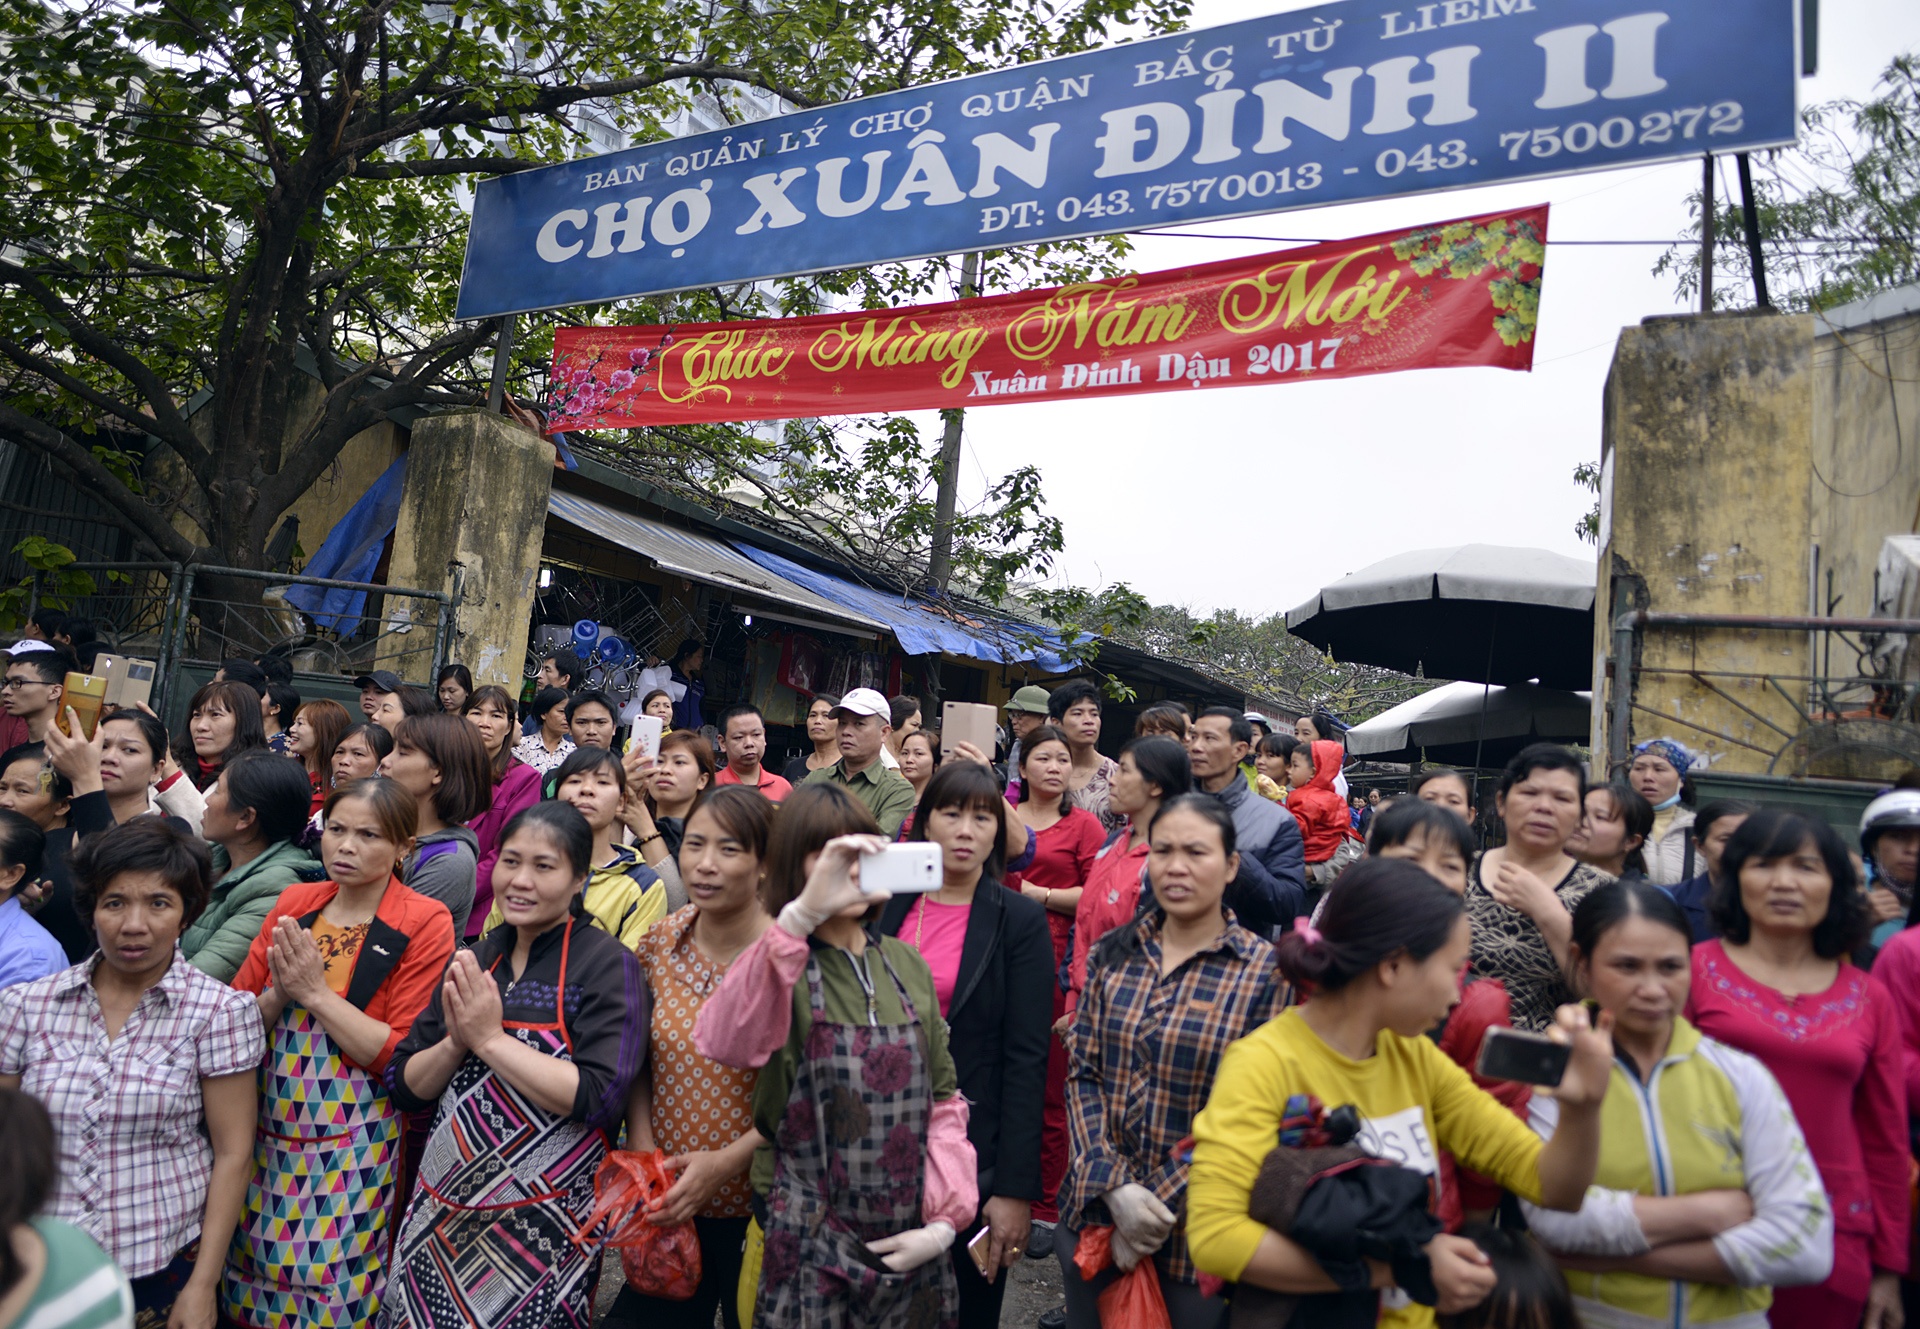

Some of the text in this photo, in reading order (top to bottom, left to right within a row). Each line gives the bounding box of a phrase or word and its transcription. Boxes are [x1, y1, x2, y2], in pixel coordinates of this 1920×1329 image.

[535, 12, 1670, 263] CHỢ XUÂN ĐỈNH II
[583, 163, 648, 193] BAN
[665, 136, 761, 177] QUẢN
[777, 118, 829, 154] LÝ
[849, 101, 934, 138] CHỢ
[960, 74, 1094, 118] QUẬN
[1133, 38, 1234, 87] BẮC
[1267, 17, 1343, 59] TỪ
[979, 200, 1045, 234] ĐT:
[1056, 190, 1135, 223] 043.
[1145, 162, 1323, 212] 7570013
[1375, 139, 1479, 178] 043.
[1499, 101, 1744, 161] 7500272
[658, 245, 1410, 403] Chúc Mừng Năm Mới
[967, 337, 1345, 397] Xuân Đinh Dậu 2017
